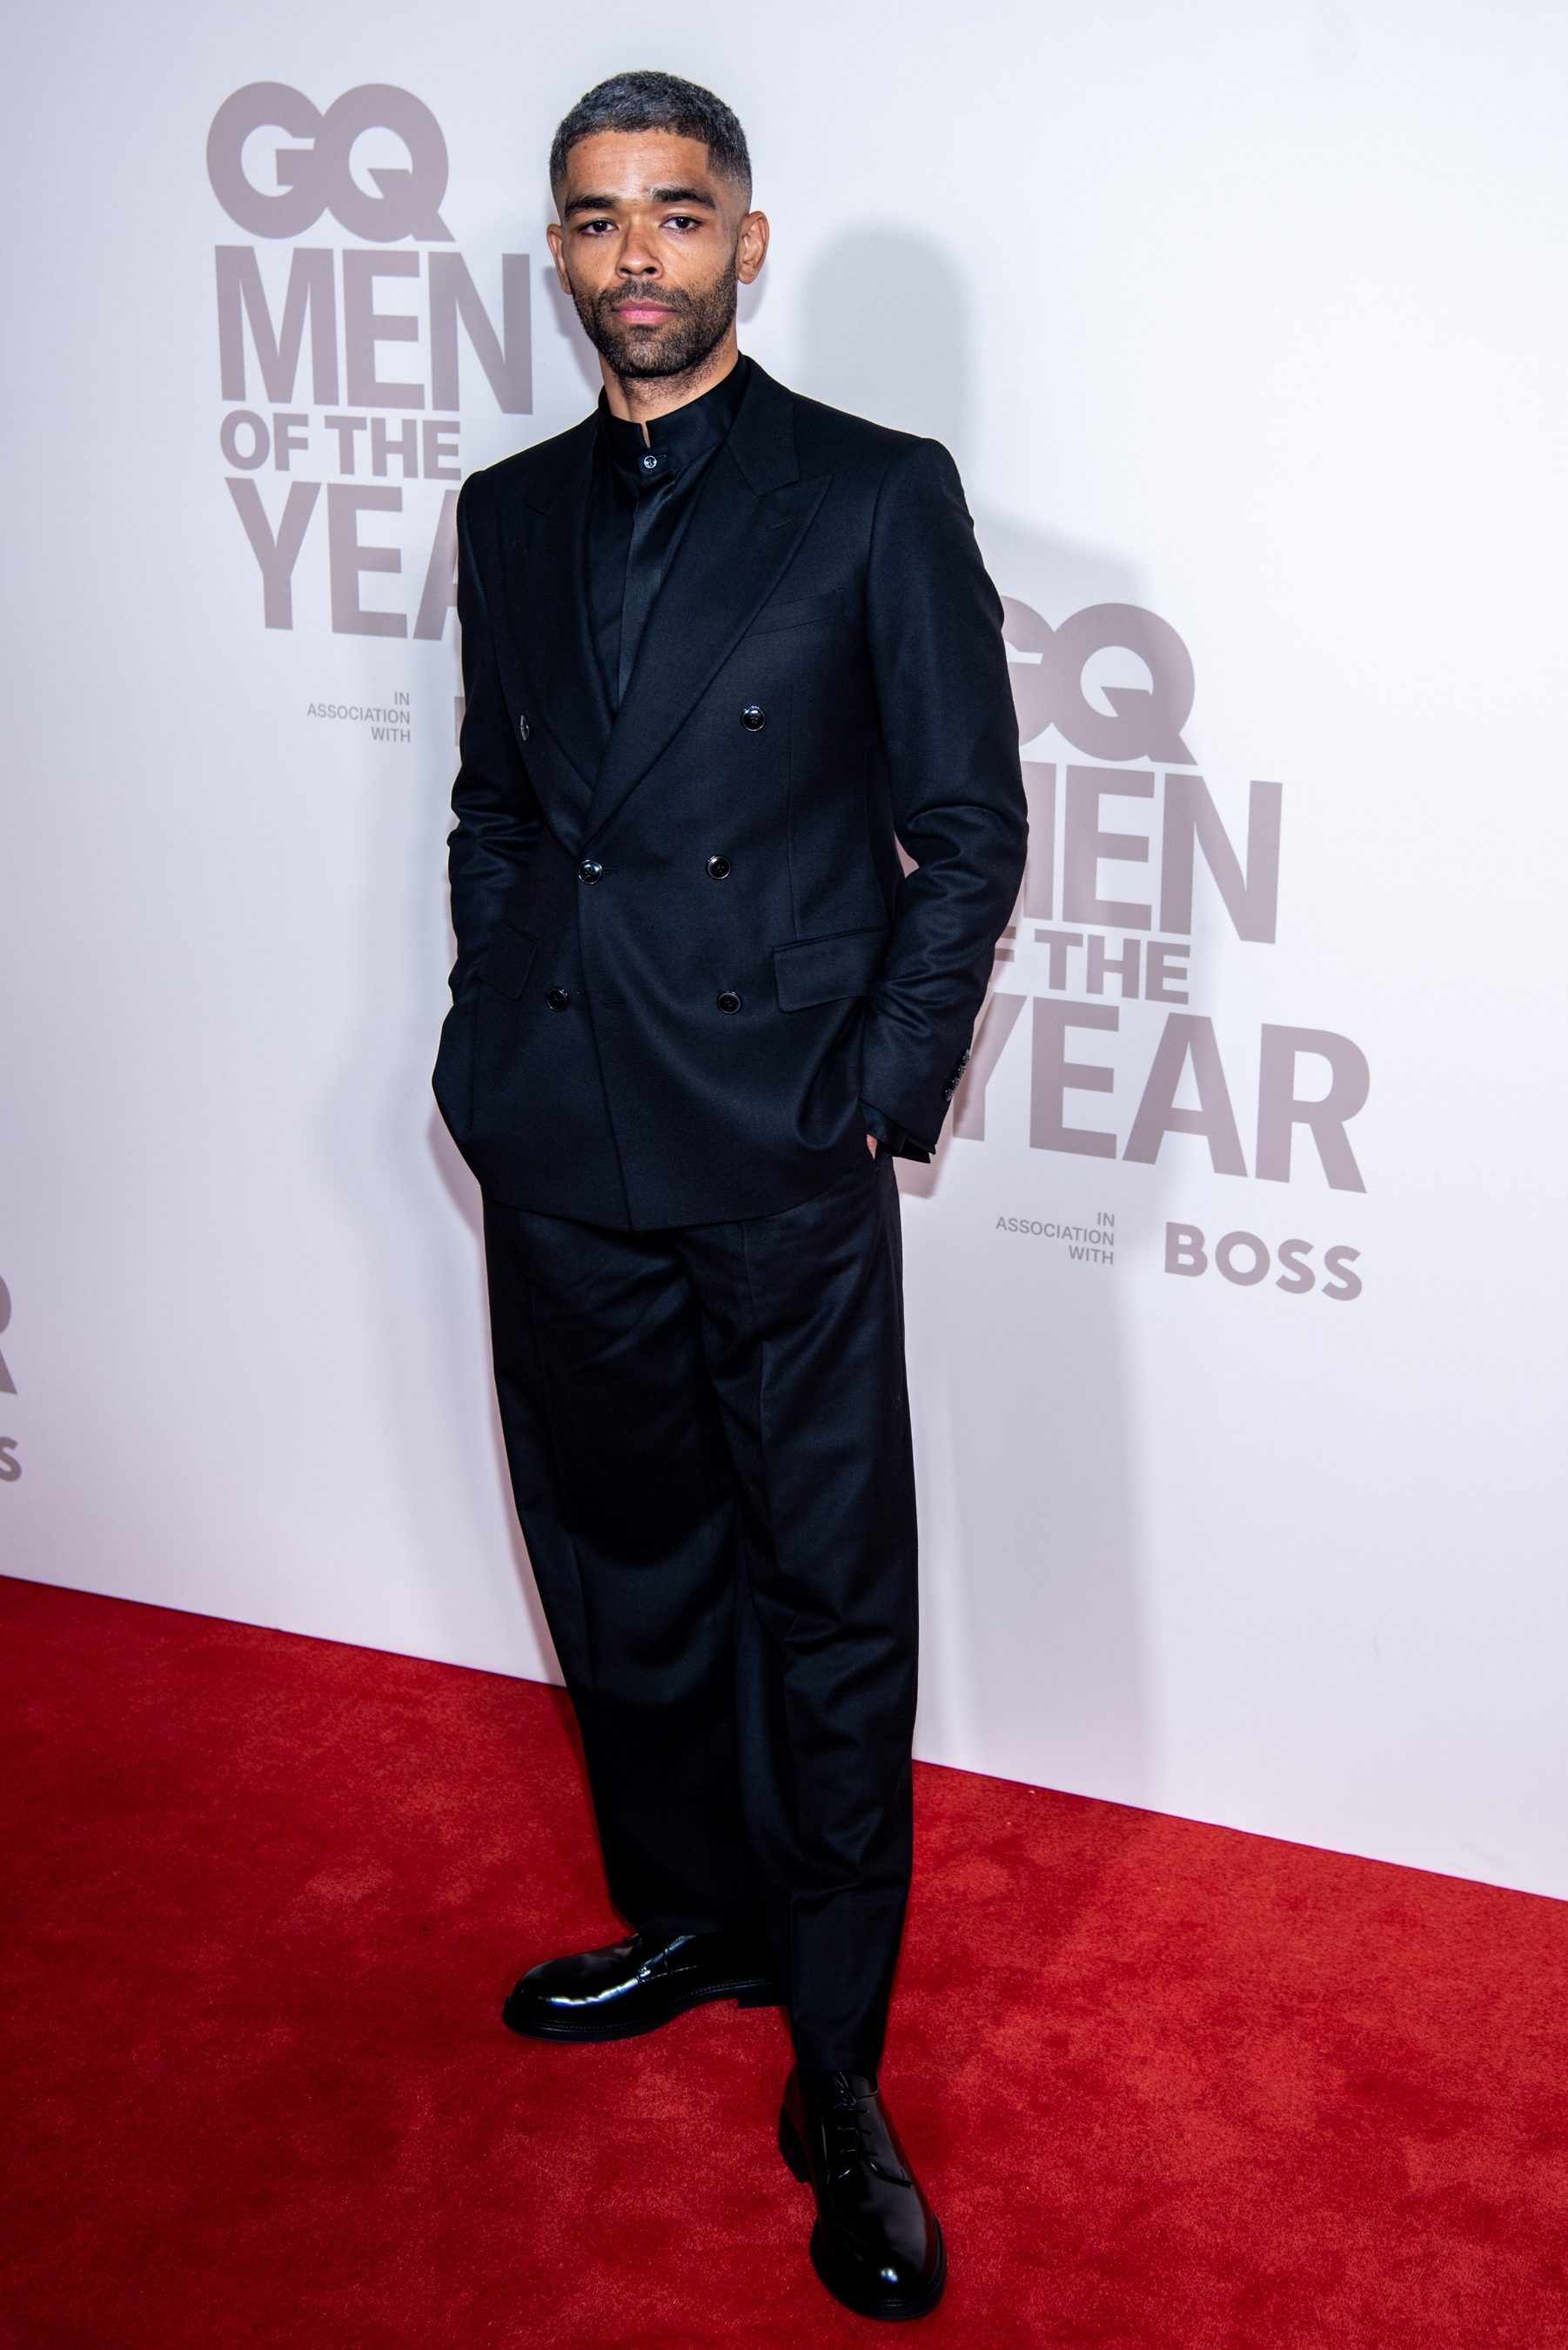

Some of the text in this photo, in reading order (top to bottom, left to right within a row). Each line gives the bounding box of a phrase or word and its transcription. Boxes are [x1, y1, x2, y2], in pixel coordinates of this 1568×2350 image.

[206, 81, 455, 242] GQ
[214, 245, 533, 415] MEN
[219, 410, 461, 480] OF THE
[306, 703, 411, 724] ASSOCIATION
[394, 692, 410, 706] IN
[371, 726, 411, 743] WITH
[1020, 760, 1283, 945] EN
[1034, 928, 1191, 1005] THE
[995, 1216, 1115, 1246] ASSOCIATION
[1096, 1211, 1116, 1228] IN
[1069, 1245, 1114, 1266] WITH
[1164, 1220, 1364, 1302] BOSS
